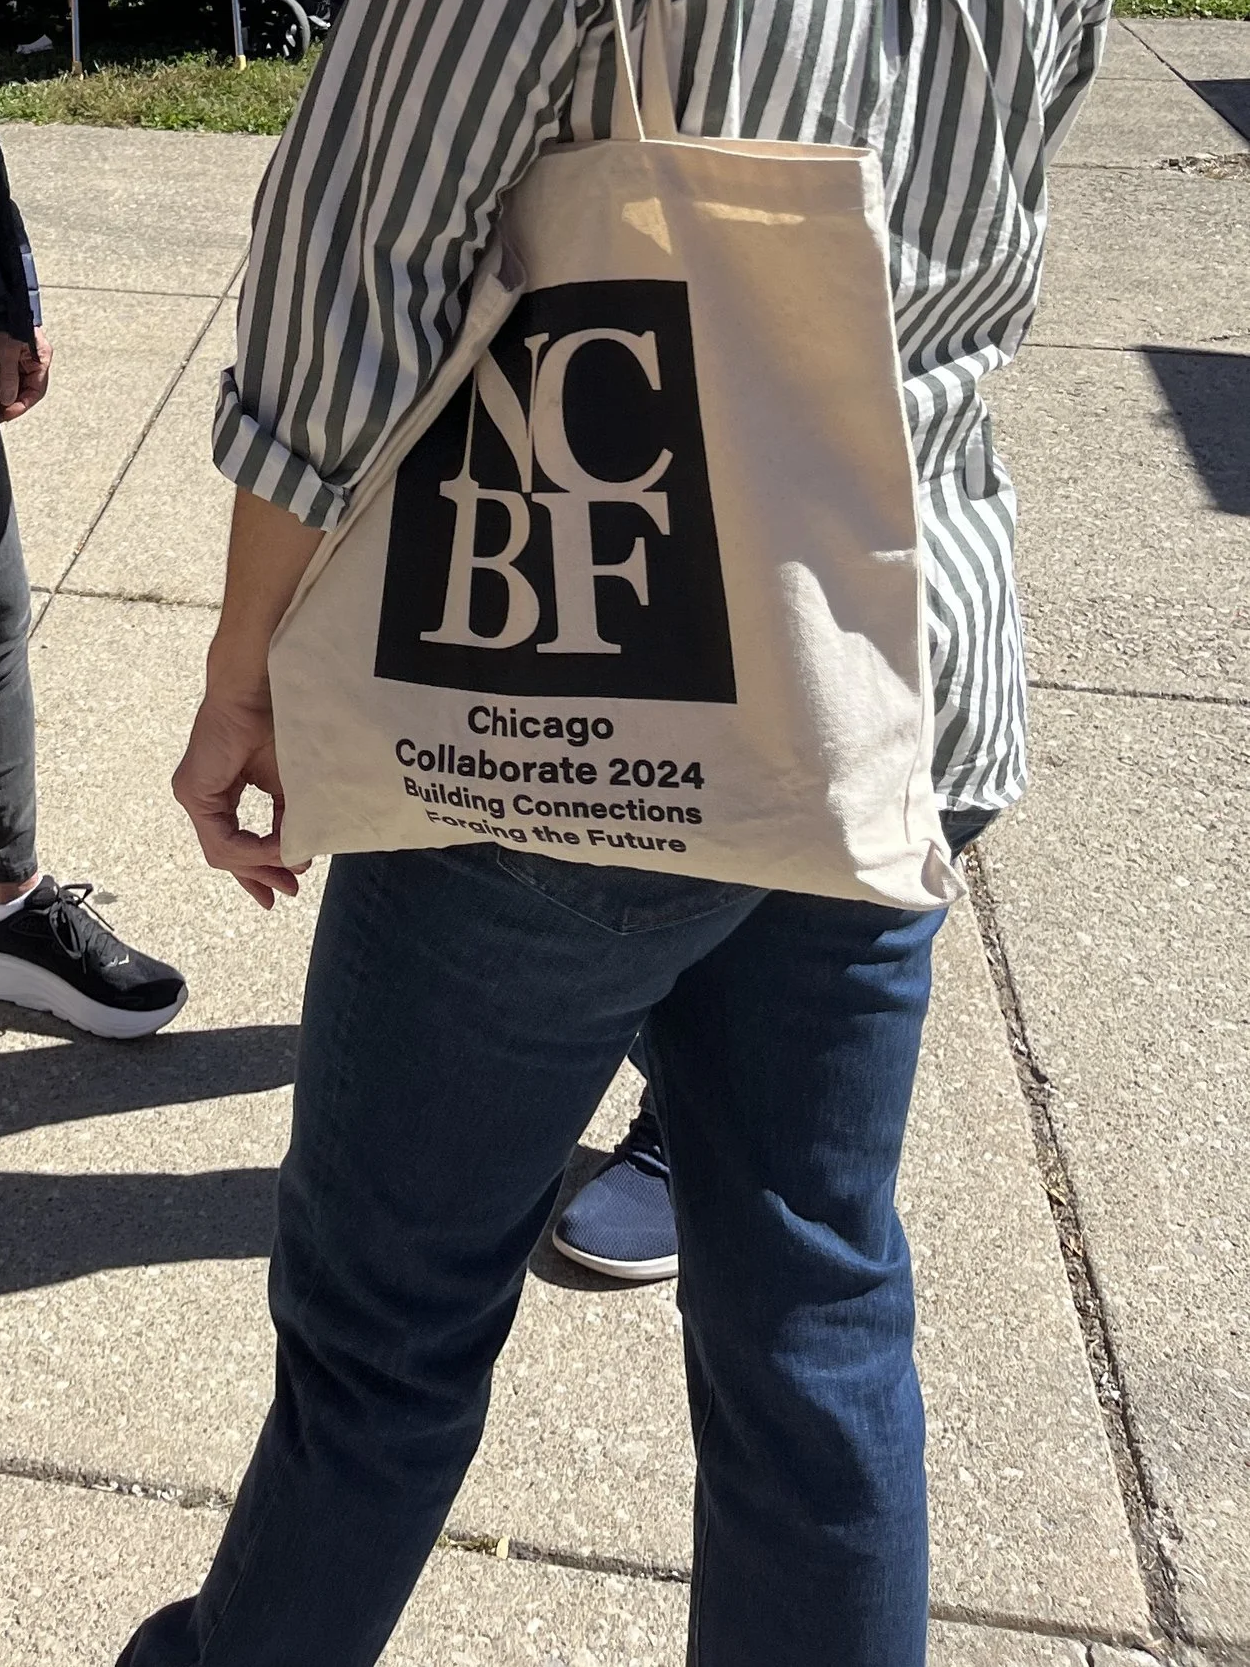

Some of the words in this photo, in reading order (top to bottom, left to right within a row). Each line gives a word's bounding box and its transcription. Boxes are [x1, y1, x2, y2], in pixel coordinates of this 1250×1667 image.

[467, 705, 614, 747] Chicago
[395, 738, 597, 785] Collaborate
[608, 757, 705, 790] 2024
[403, 776, 505, 819] Building
[512, 794, 703, 825] Connections
[425, 809, 528, 844] Forging
[531, 826, 581, 846] the
[586, 828, 688, 853] Future
